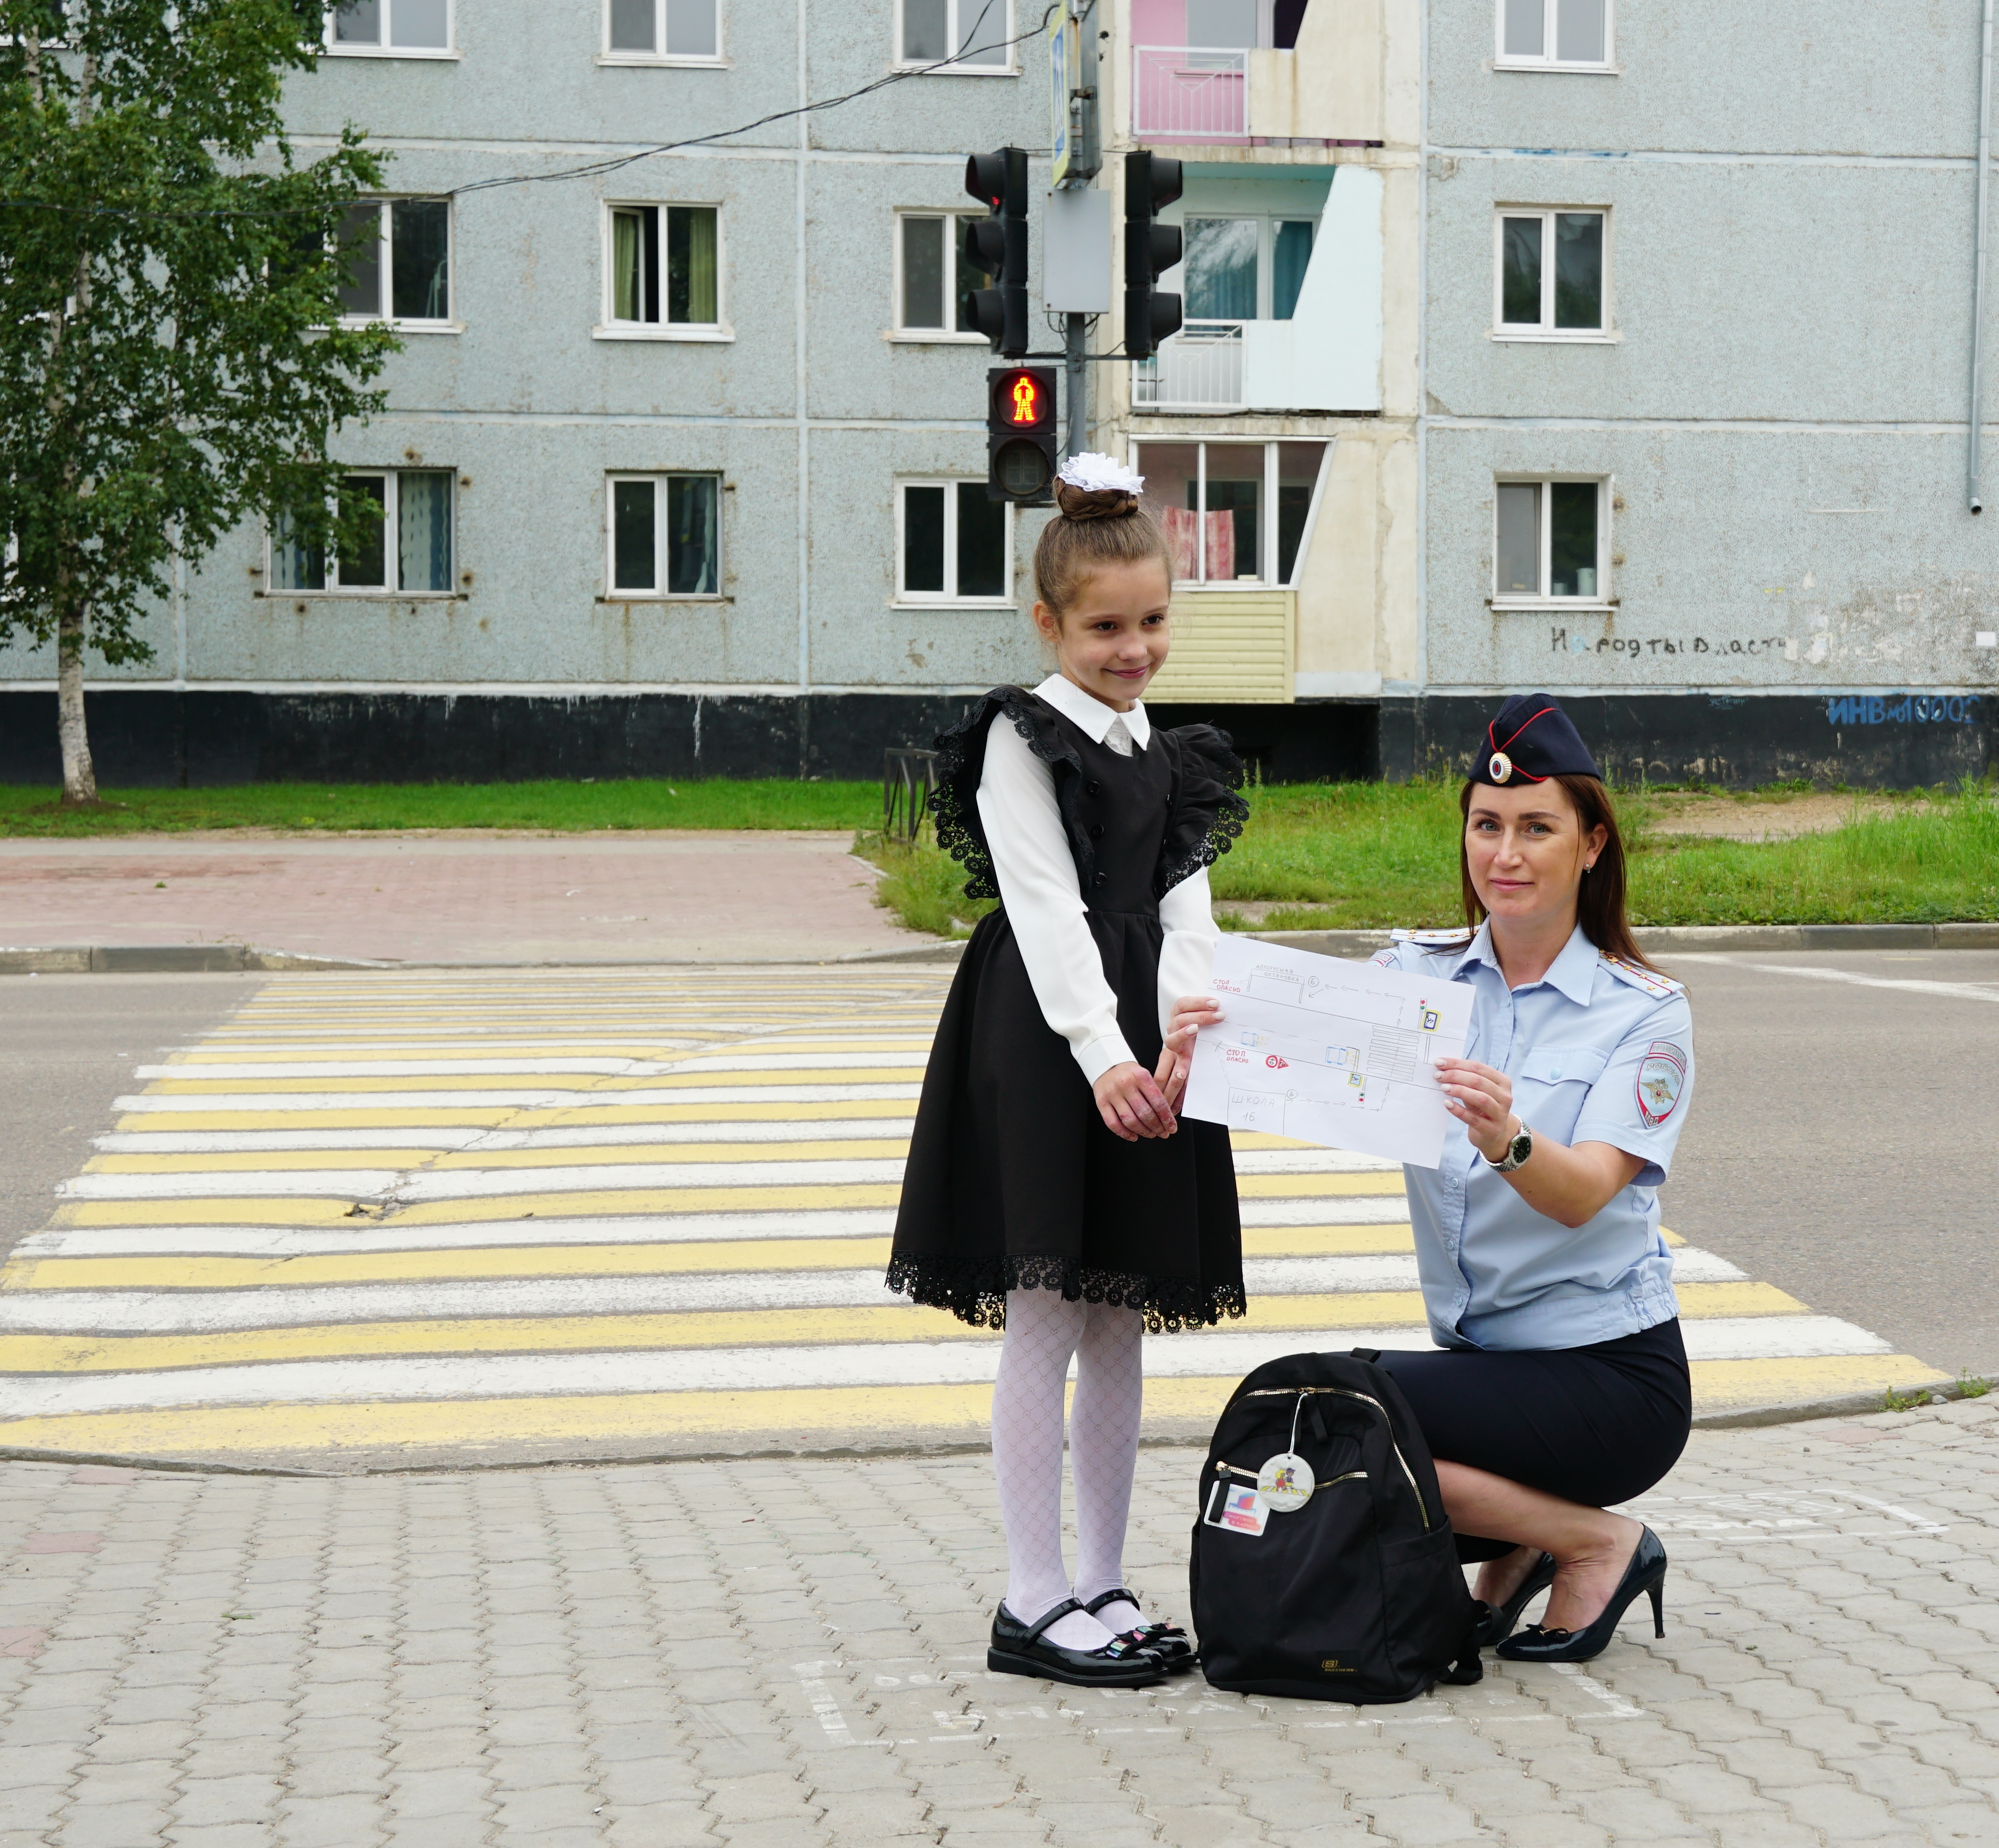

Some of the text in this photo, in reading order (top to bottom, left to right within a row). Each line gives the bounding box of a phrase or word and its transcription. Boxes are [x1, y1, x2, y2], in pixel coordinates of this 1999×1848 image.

[1255, 964, 1293, 974] АВТОБУСНАЯ
[1264, 972, 1299, 982] ОСТАНОВКА
[1216, 984, 1241, 993] ОПАСНО
[1226, 1049, 1246, 1057] СТОП
[1232, 1094, 1275, 1107] ШКОЛА
[1243, 1111, 1255, 1122] 16
[1226, 1512, 1253, 1523] СМАРТФОН
